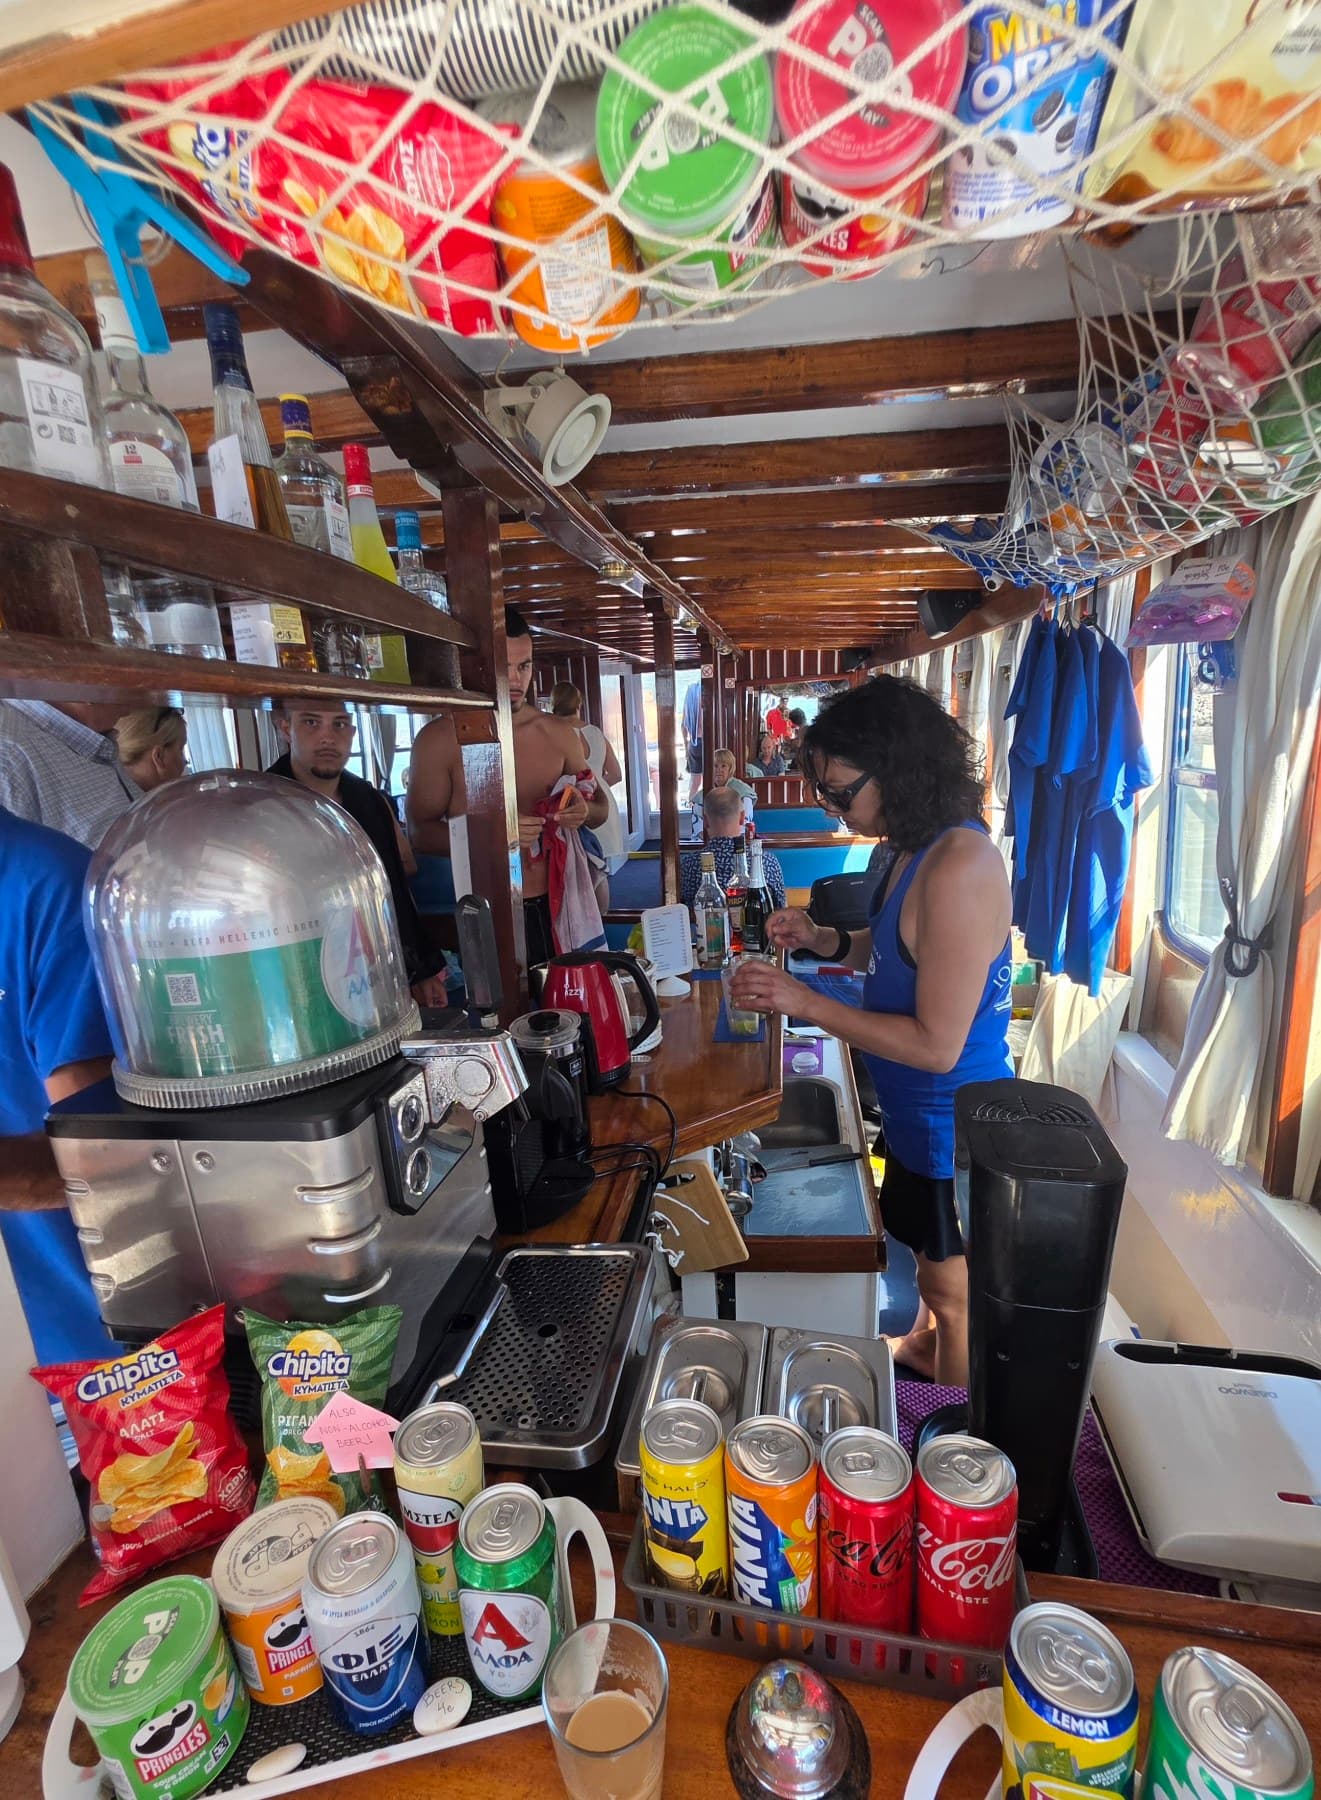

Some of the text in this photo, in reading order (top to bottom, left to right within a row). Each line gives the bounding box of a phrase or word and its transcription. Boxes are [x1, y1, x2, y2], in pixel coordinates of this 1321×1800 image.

[858, 4, 885, 39] SCAN
[218, 926, 280, 944] HELLENIC
[77, 1350, 178, 1402] Chipita
[267, 1351, 351, 1380] Chipita
[121, 1372, 183, 1407] ΚΥΜΑΤΙΣΤΑ
[294, 1380, 348, 1395] ΚΥΜΑΤΙΣΤΑ
[119, 1410, 166, 1439] ΑΛΑΤΙ
[278, 1415, 318, 1427] ΡΙΓΑΝ
[329, 1408, 357, 1419] ALSO
[218, 1465, 248, 1501] ΧΩΡΙΣ
[403, 1504, 457, 1526] ΜΣΤΕΛ
[643, 1487, 706, 1528] ANTA
[948, 1589, 990, 1605] TASTE
[353, 1623, 376, 1638] 1864
[267, 1641, 313, 1673] PRINGL
[331, 1623, 404, 1670] ΦΙΞ
[473, 1646, 534, 1669] ΑΛΦΑ
[351, 1655, 396, 1683] ΕΛΛΑΣ
[423, 1678, 465, 1708] BEERS
[1051, 1706, 1110, 1737] LEMON
[138, 1721, 208, 1781] PRINGLES
[152, 1750, 207, 1789] SOUR CREAM
